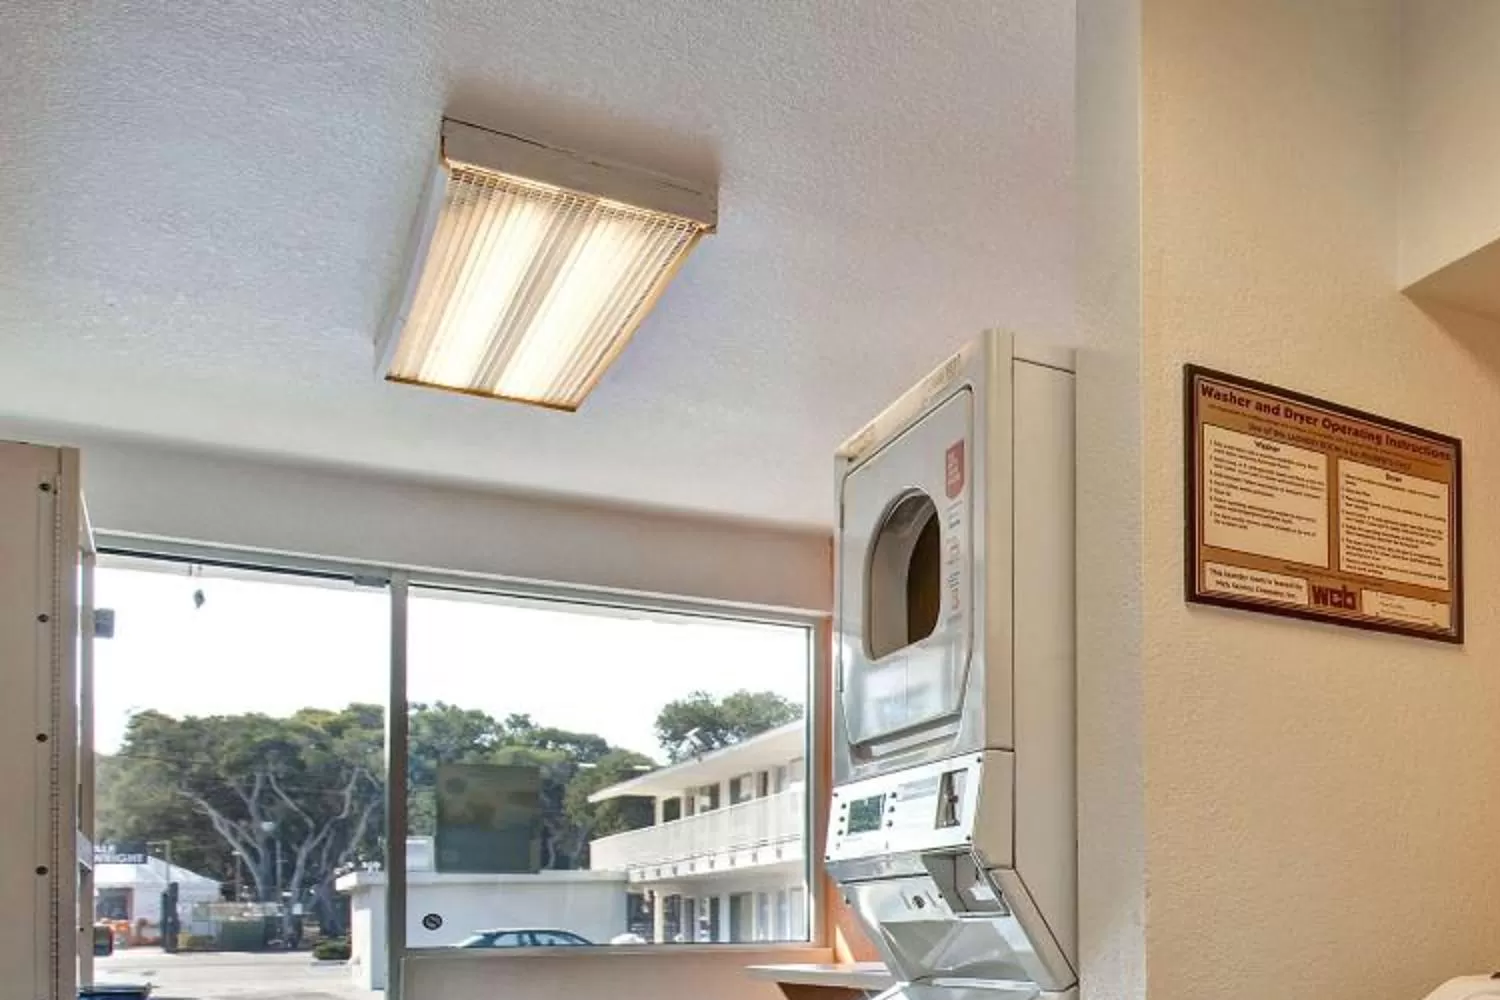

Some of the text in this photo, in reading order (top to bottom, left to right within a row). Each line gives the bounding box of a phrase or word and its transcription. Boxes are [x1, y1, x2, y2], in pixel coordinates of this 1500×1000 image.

[1201, 384, 1250, 409] Washer
[1256, 400, 1281, 416] and
[1284, 407, 1319, 428] Dryer
[1322, 417, 1383, 445] Operating
[1386, 435, 1452, 462] Instructions
